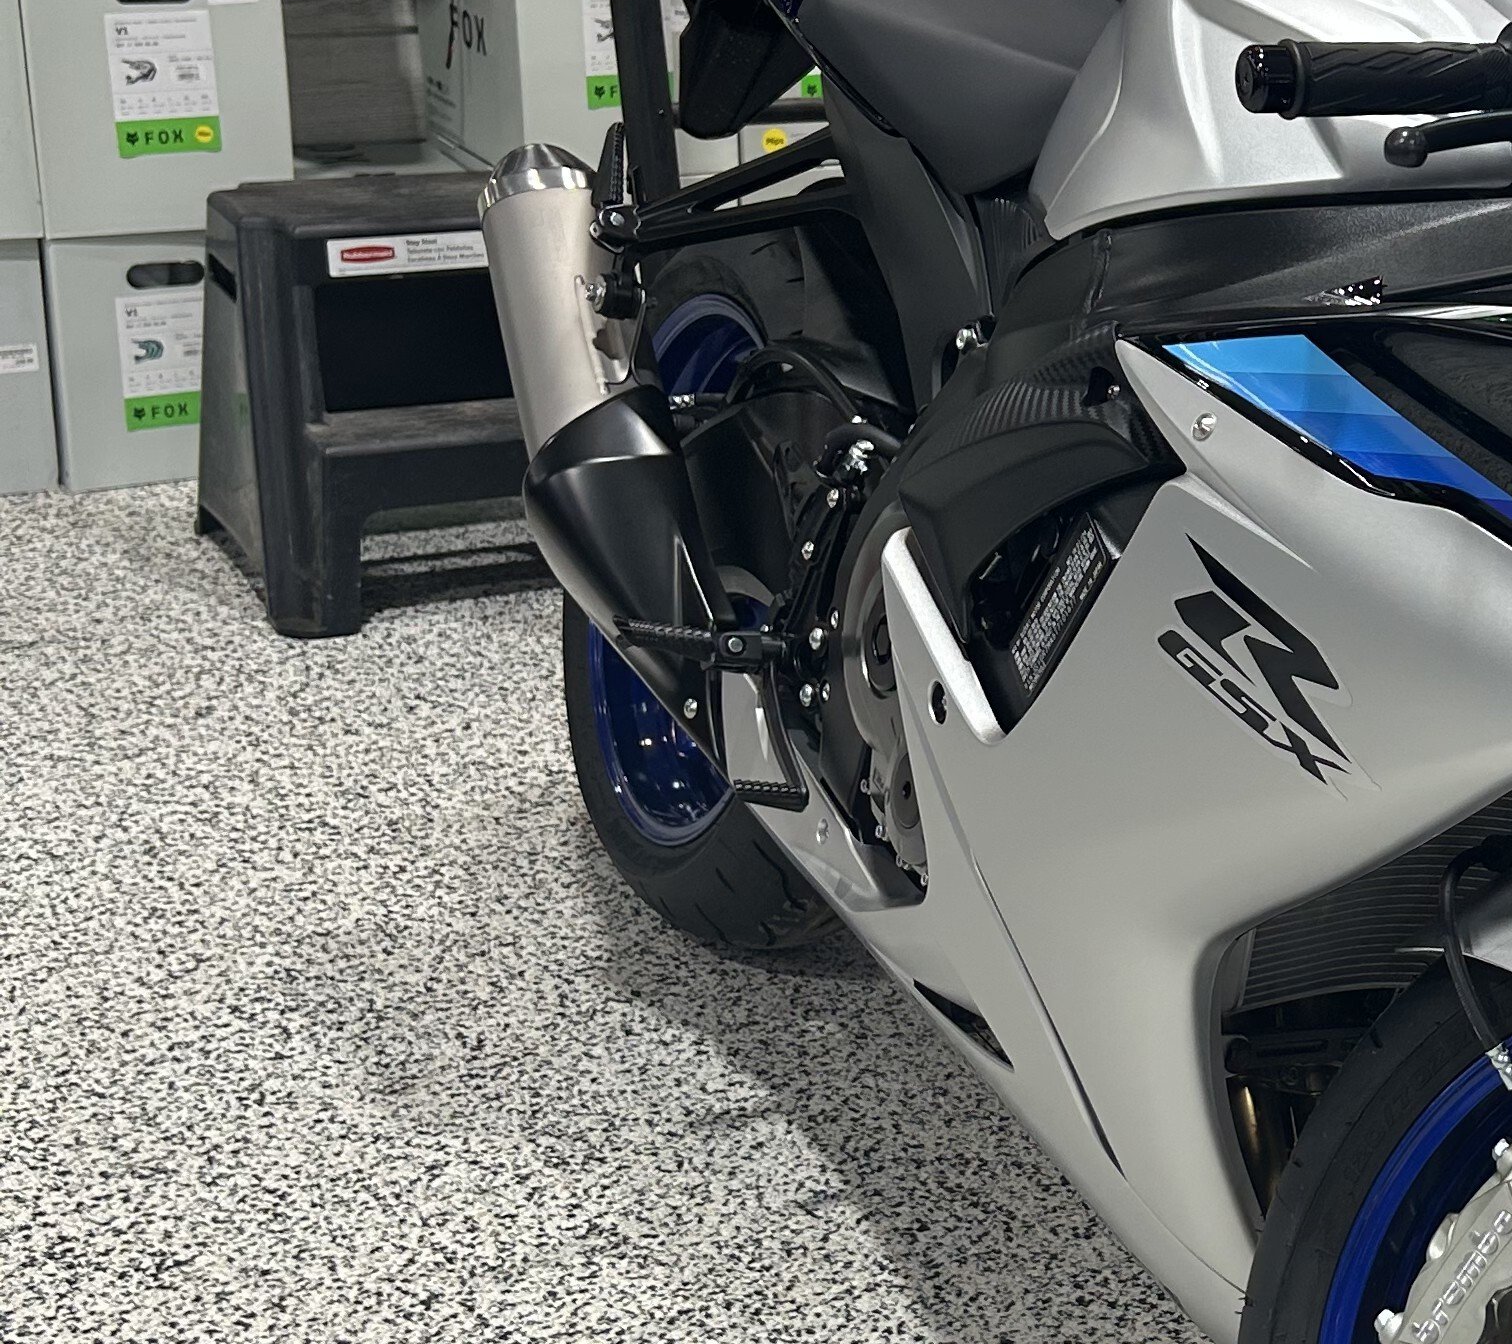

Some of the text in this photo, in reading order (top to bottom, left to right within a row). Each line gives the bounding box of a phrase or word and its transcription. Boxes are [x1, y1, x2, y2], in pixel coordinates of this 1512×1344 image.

[450, 2, 487, 56] FOX
[143, 129, 185, 146] FOX
[151, 402, 188, 420] FOX
[1157, 629, 1352, 786] GSX
